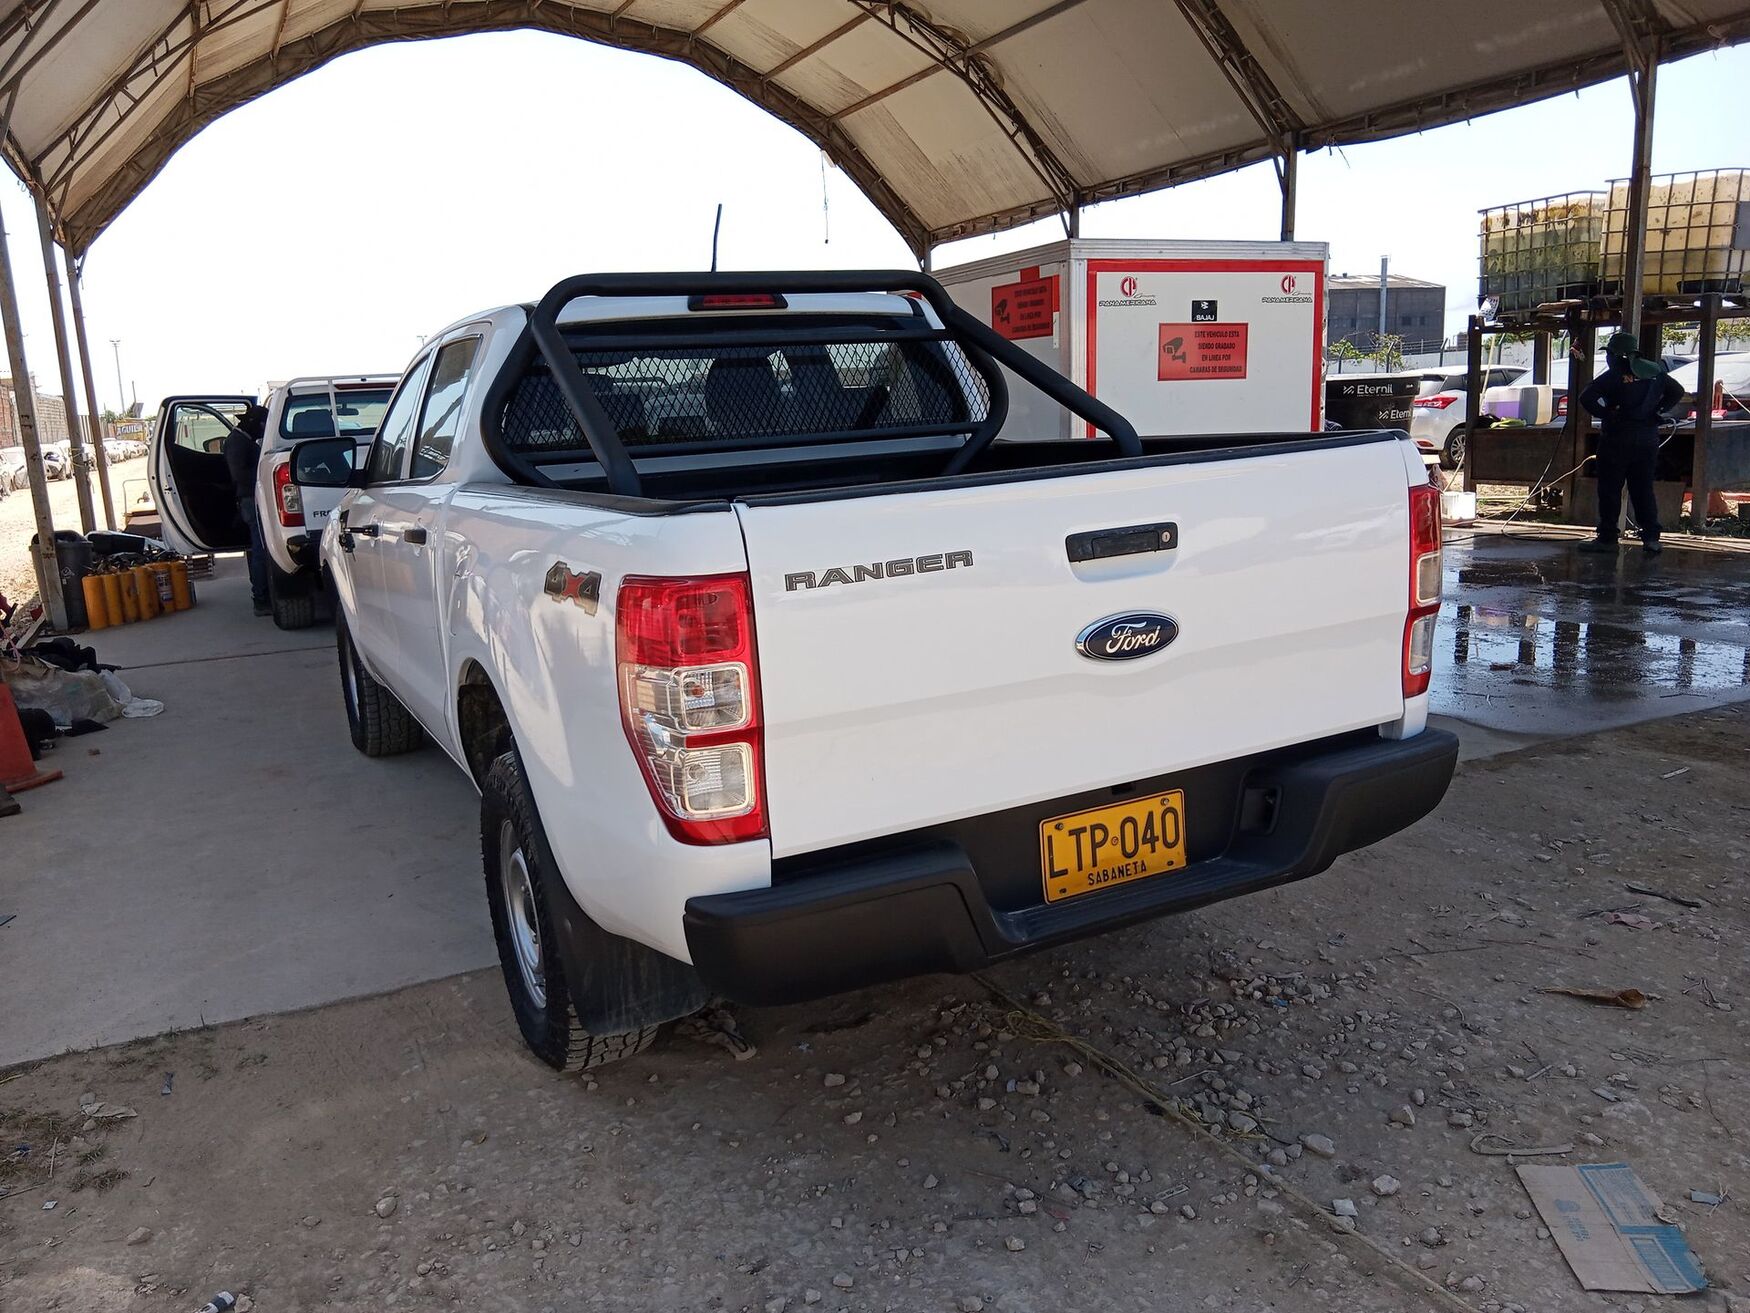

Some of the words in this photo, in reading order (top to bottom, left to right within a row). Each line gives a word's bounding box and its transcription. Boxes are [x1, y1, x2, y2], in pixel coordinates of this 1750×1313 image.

[1098, 299, 1157, 307] PANAMERICANA
[1261, 296, 1313, 304] PANAMERICANA
[1194, 330, 1206, 338] ESTE
[1206, 330, 1228, 338] VEHICULO
[1228, 330, 1240, 338] ESTA
[1198, 342, 1214, 350] SIENDO
[1215, 342, 1236, 350] GRABADO
[1221, 353, 1231, 361] POR
[1357, 384, 1393, 394] Eternil
[784, 549, 974, 592] RANGER
[1105, 621, 1161, 654] Ford
[1088, 860, 1147, 886] SABANETA
